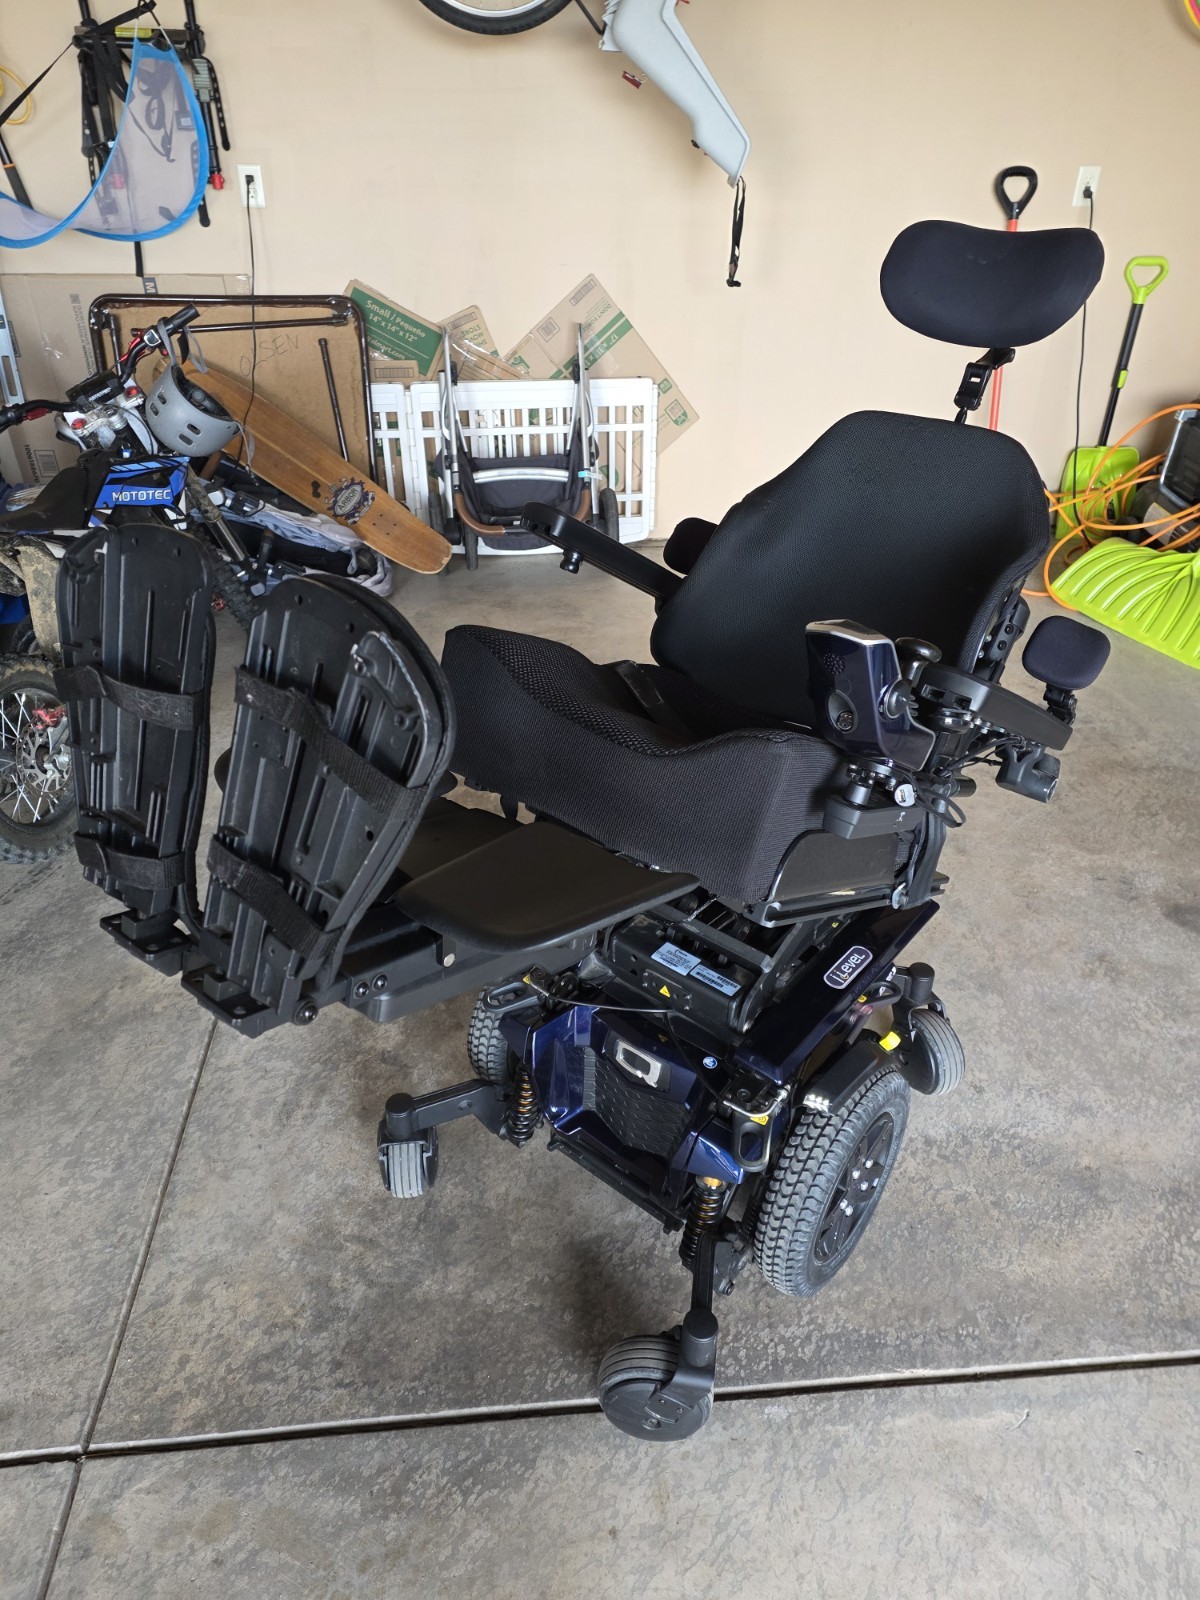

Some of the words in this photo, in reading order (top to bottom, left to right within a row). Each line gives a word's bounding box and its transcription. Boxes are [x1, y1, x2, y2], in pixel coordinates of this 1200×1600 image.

[366, 300, 391, 318] Small
[395, 316, 426, 338] Pequeño
[369, 313, 382, 323] 14"
[386, 323, 400, 333] 14"
[399, 329, 405, 337] x
[404, 333, 418, 343] 12"
[112, 489, 171, 502] MOTOTEC
[337, 487, 358, 510] ARBOR
